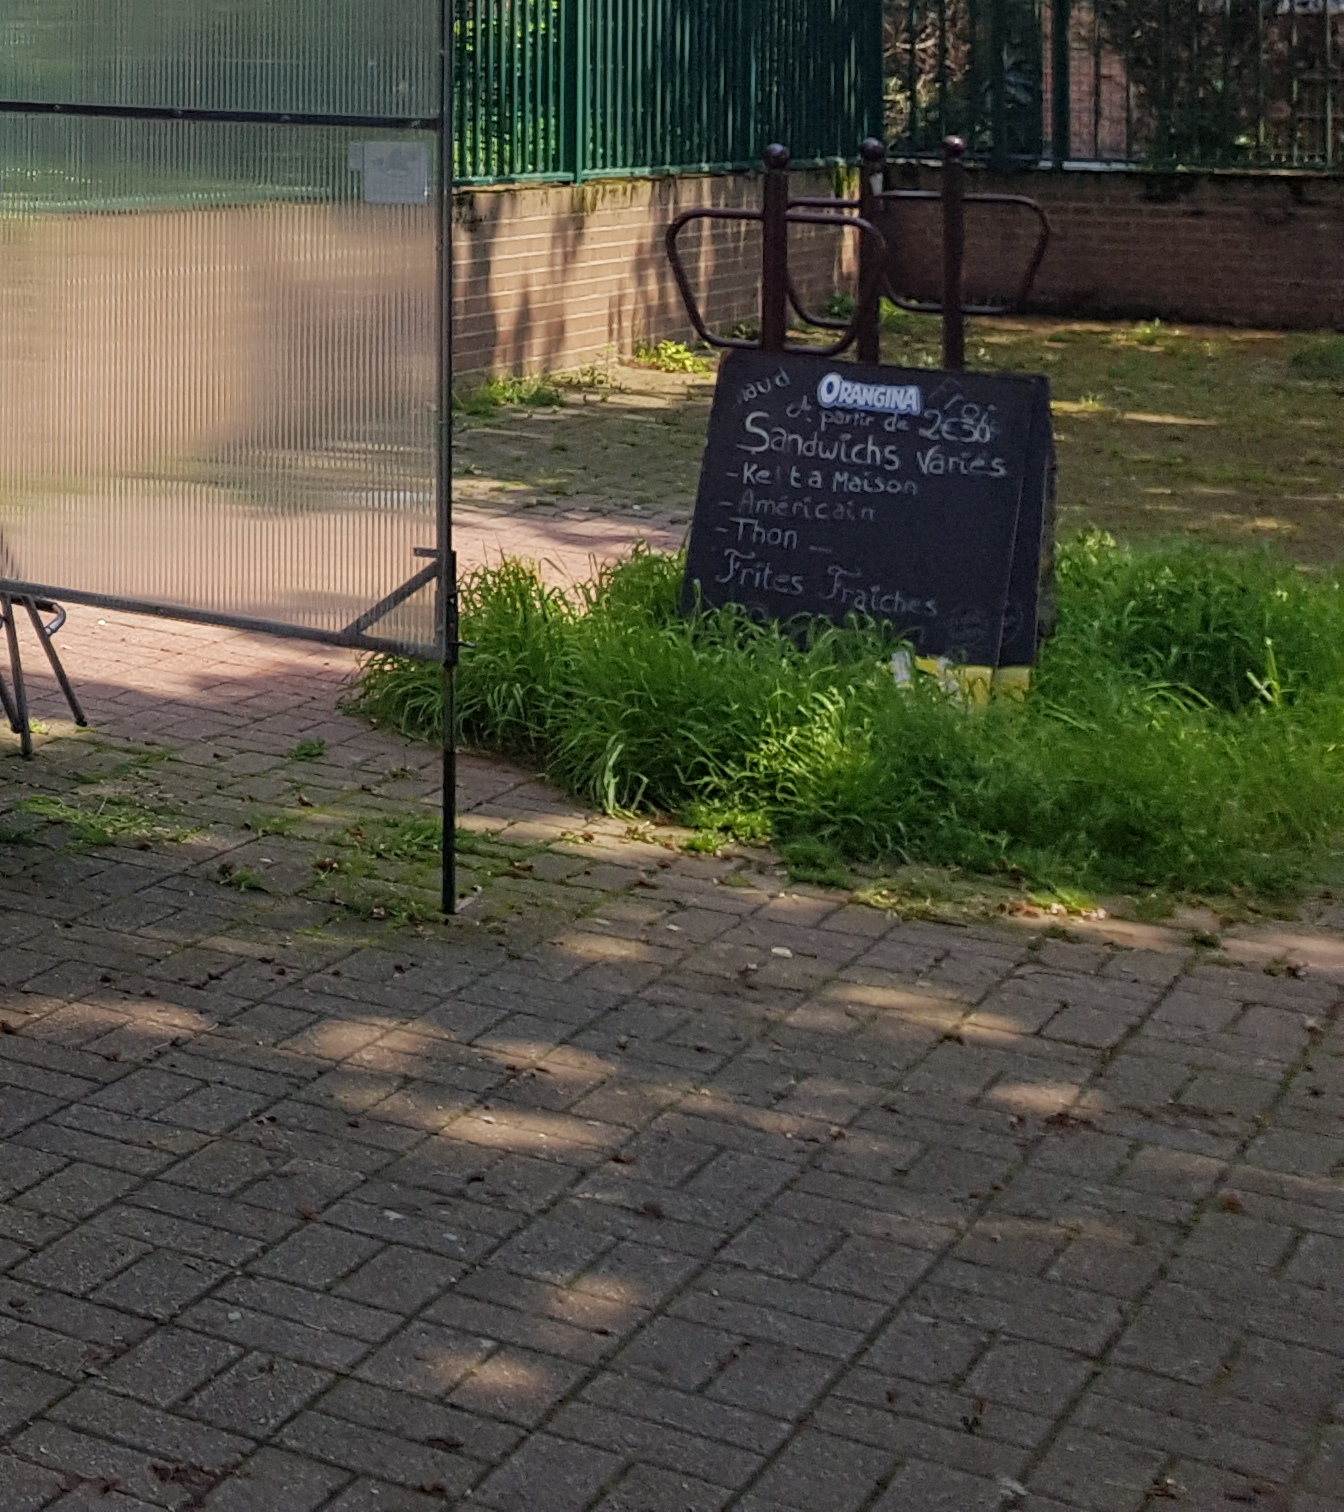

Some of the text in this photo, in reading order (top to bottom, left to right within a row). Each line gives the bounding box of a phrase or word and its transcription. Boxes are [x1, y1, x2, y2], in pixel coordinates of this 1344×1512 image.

[817, 372, 923, 414] ORANGINA
[736, 410, 901, 472] Sandwichs
[820, 409, 875, 432] partir
[883, 411, 910, 432] de
[832, 471, 919, 496] Maison
[714, 548, 805, 596] Frites
